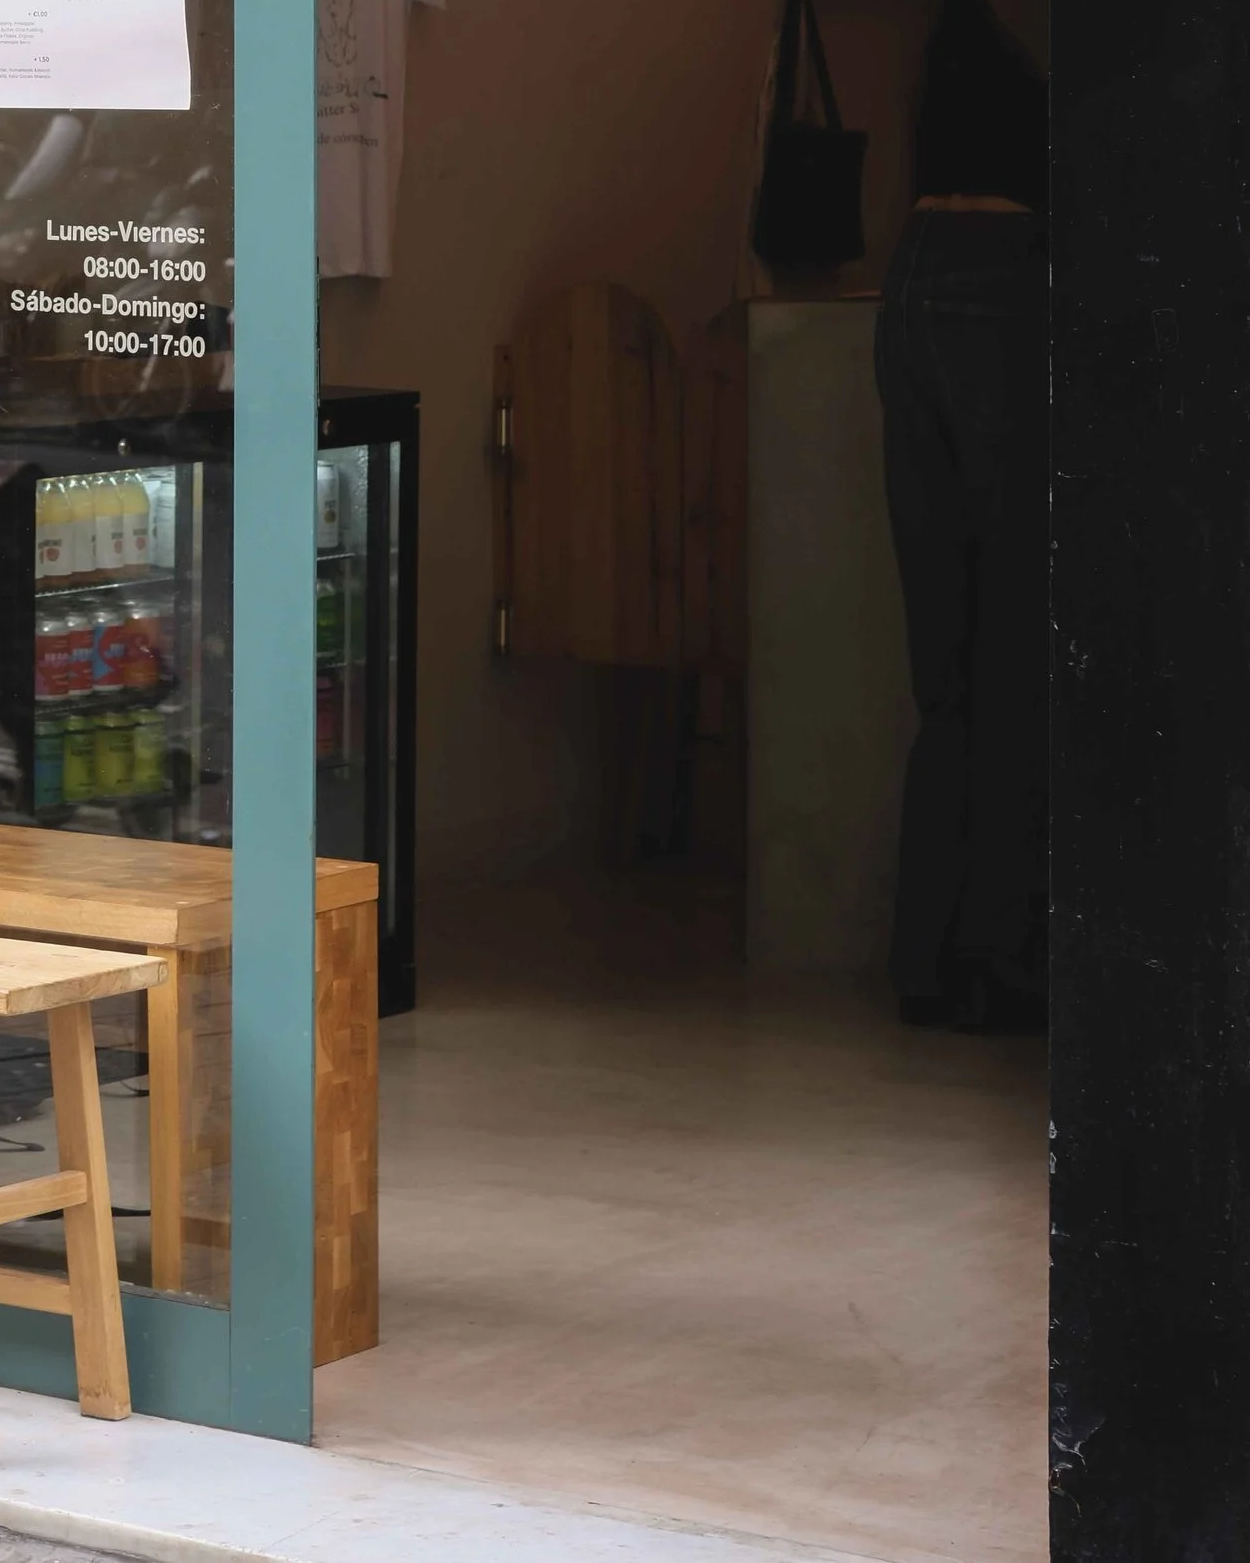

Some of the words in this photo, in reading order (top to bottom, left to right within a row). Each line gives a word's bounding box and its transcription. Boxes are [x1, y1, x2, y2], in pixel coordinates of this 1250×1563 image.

[46, 220, 205, 244] Lunes-Viernes:
[83, 257, 206, 282] 08:00-16:00
[10, 290, 206, 324] Sábado-Domingo:
[84, 330, 206, 358] 10:00-17:00
